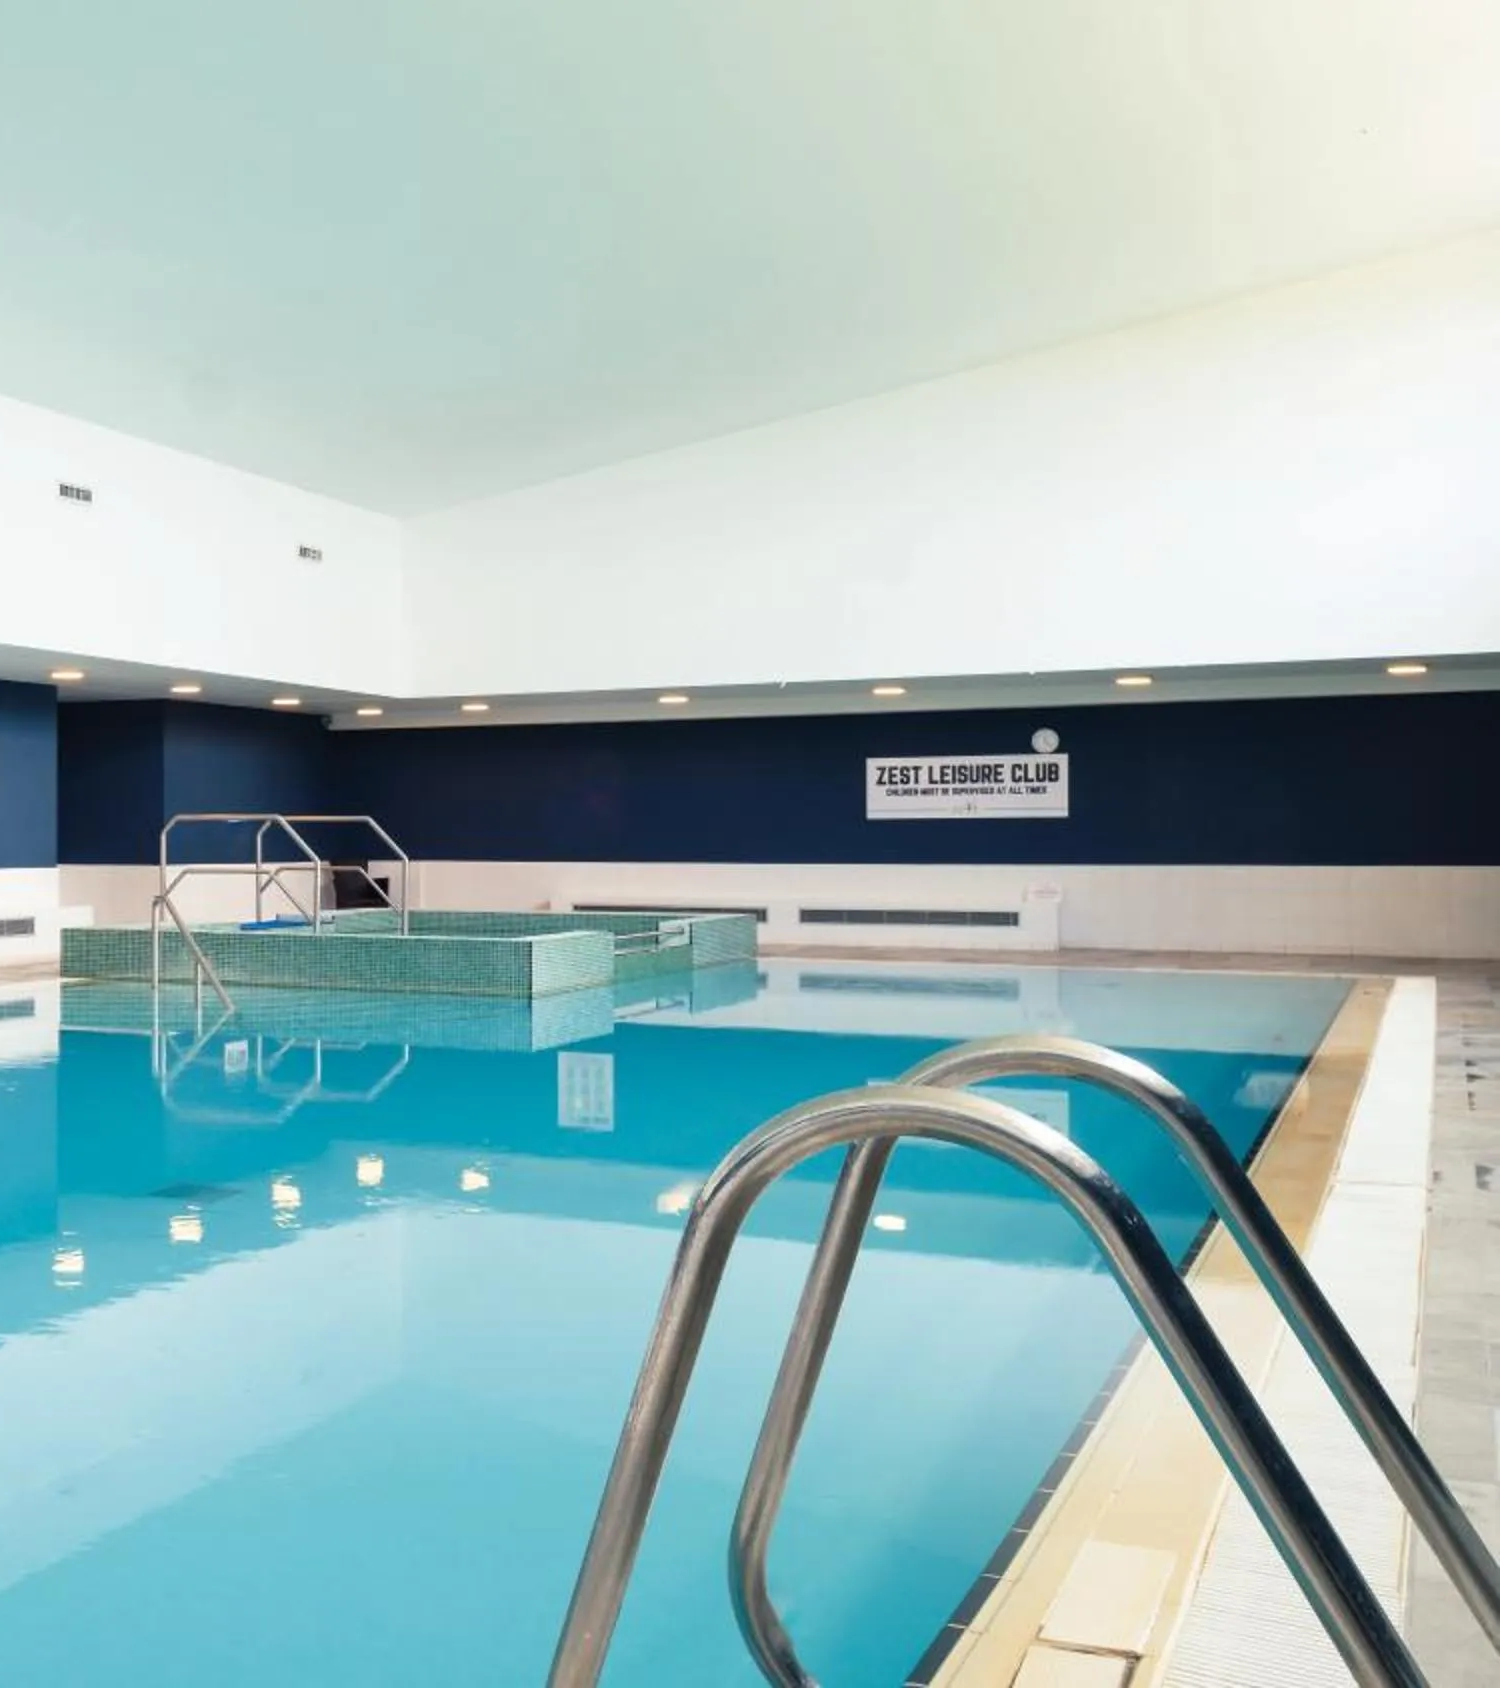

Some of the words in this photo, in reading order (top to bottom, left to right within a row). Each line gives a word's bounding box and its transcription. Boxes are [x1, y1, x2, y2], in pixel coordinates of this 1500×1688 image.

[875, 765, 922, 786] ZEST
[928, 763, 1005, 785] LEISURE
[1011, 762, 1060, 784] CLUB
[997, 786, 1006, 795] AT
[1008, 785, 1023, 795] ALL
